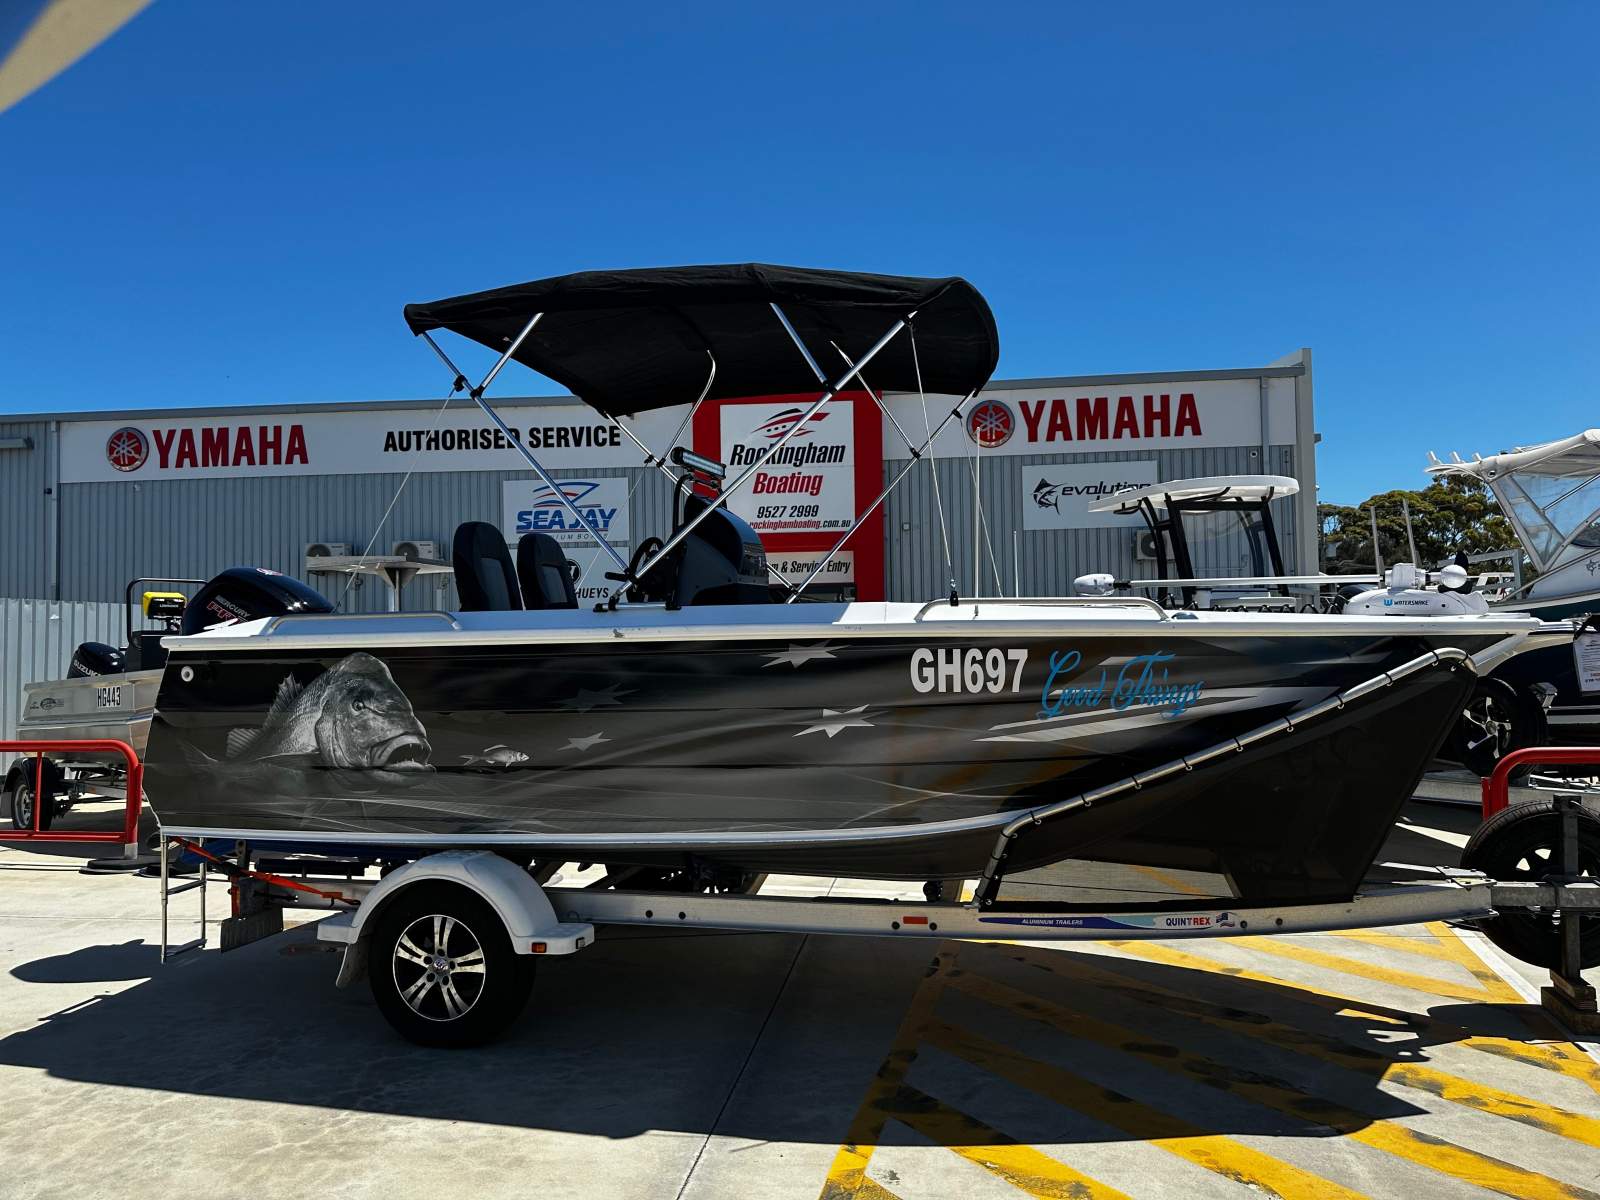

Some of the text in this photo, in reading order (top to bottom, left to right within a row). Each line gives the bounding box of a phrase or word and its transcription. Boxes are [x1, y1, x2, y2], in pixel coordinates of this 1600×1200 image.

[1018, 393, 1202, 442] YAMAHA
[152, 425, 309, 469] YAMAHA
[383, 425, 621, 452] AUTHORISED SERVICE
[729, 442, 846, 468] Rockingham
[752, 472, 824, 496] Boating
[516, 508, 617, 530] SEA JAY
[757, 505, 820, 518] 9527 2999
[781, 561, 788, 573] &
[827, 560, 851, 574] Entry
[910, 648, 1205, 720] GH697 Good Things
[97, 686, 121, 707] HG443
[1022, 918, 1054, 926] ALUMINIUM
[1165, 917, 1211, 927] QUINTREX
